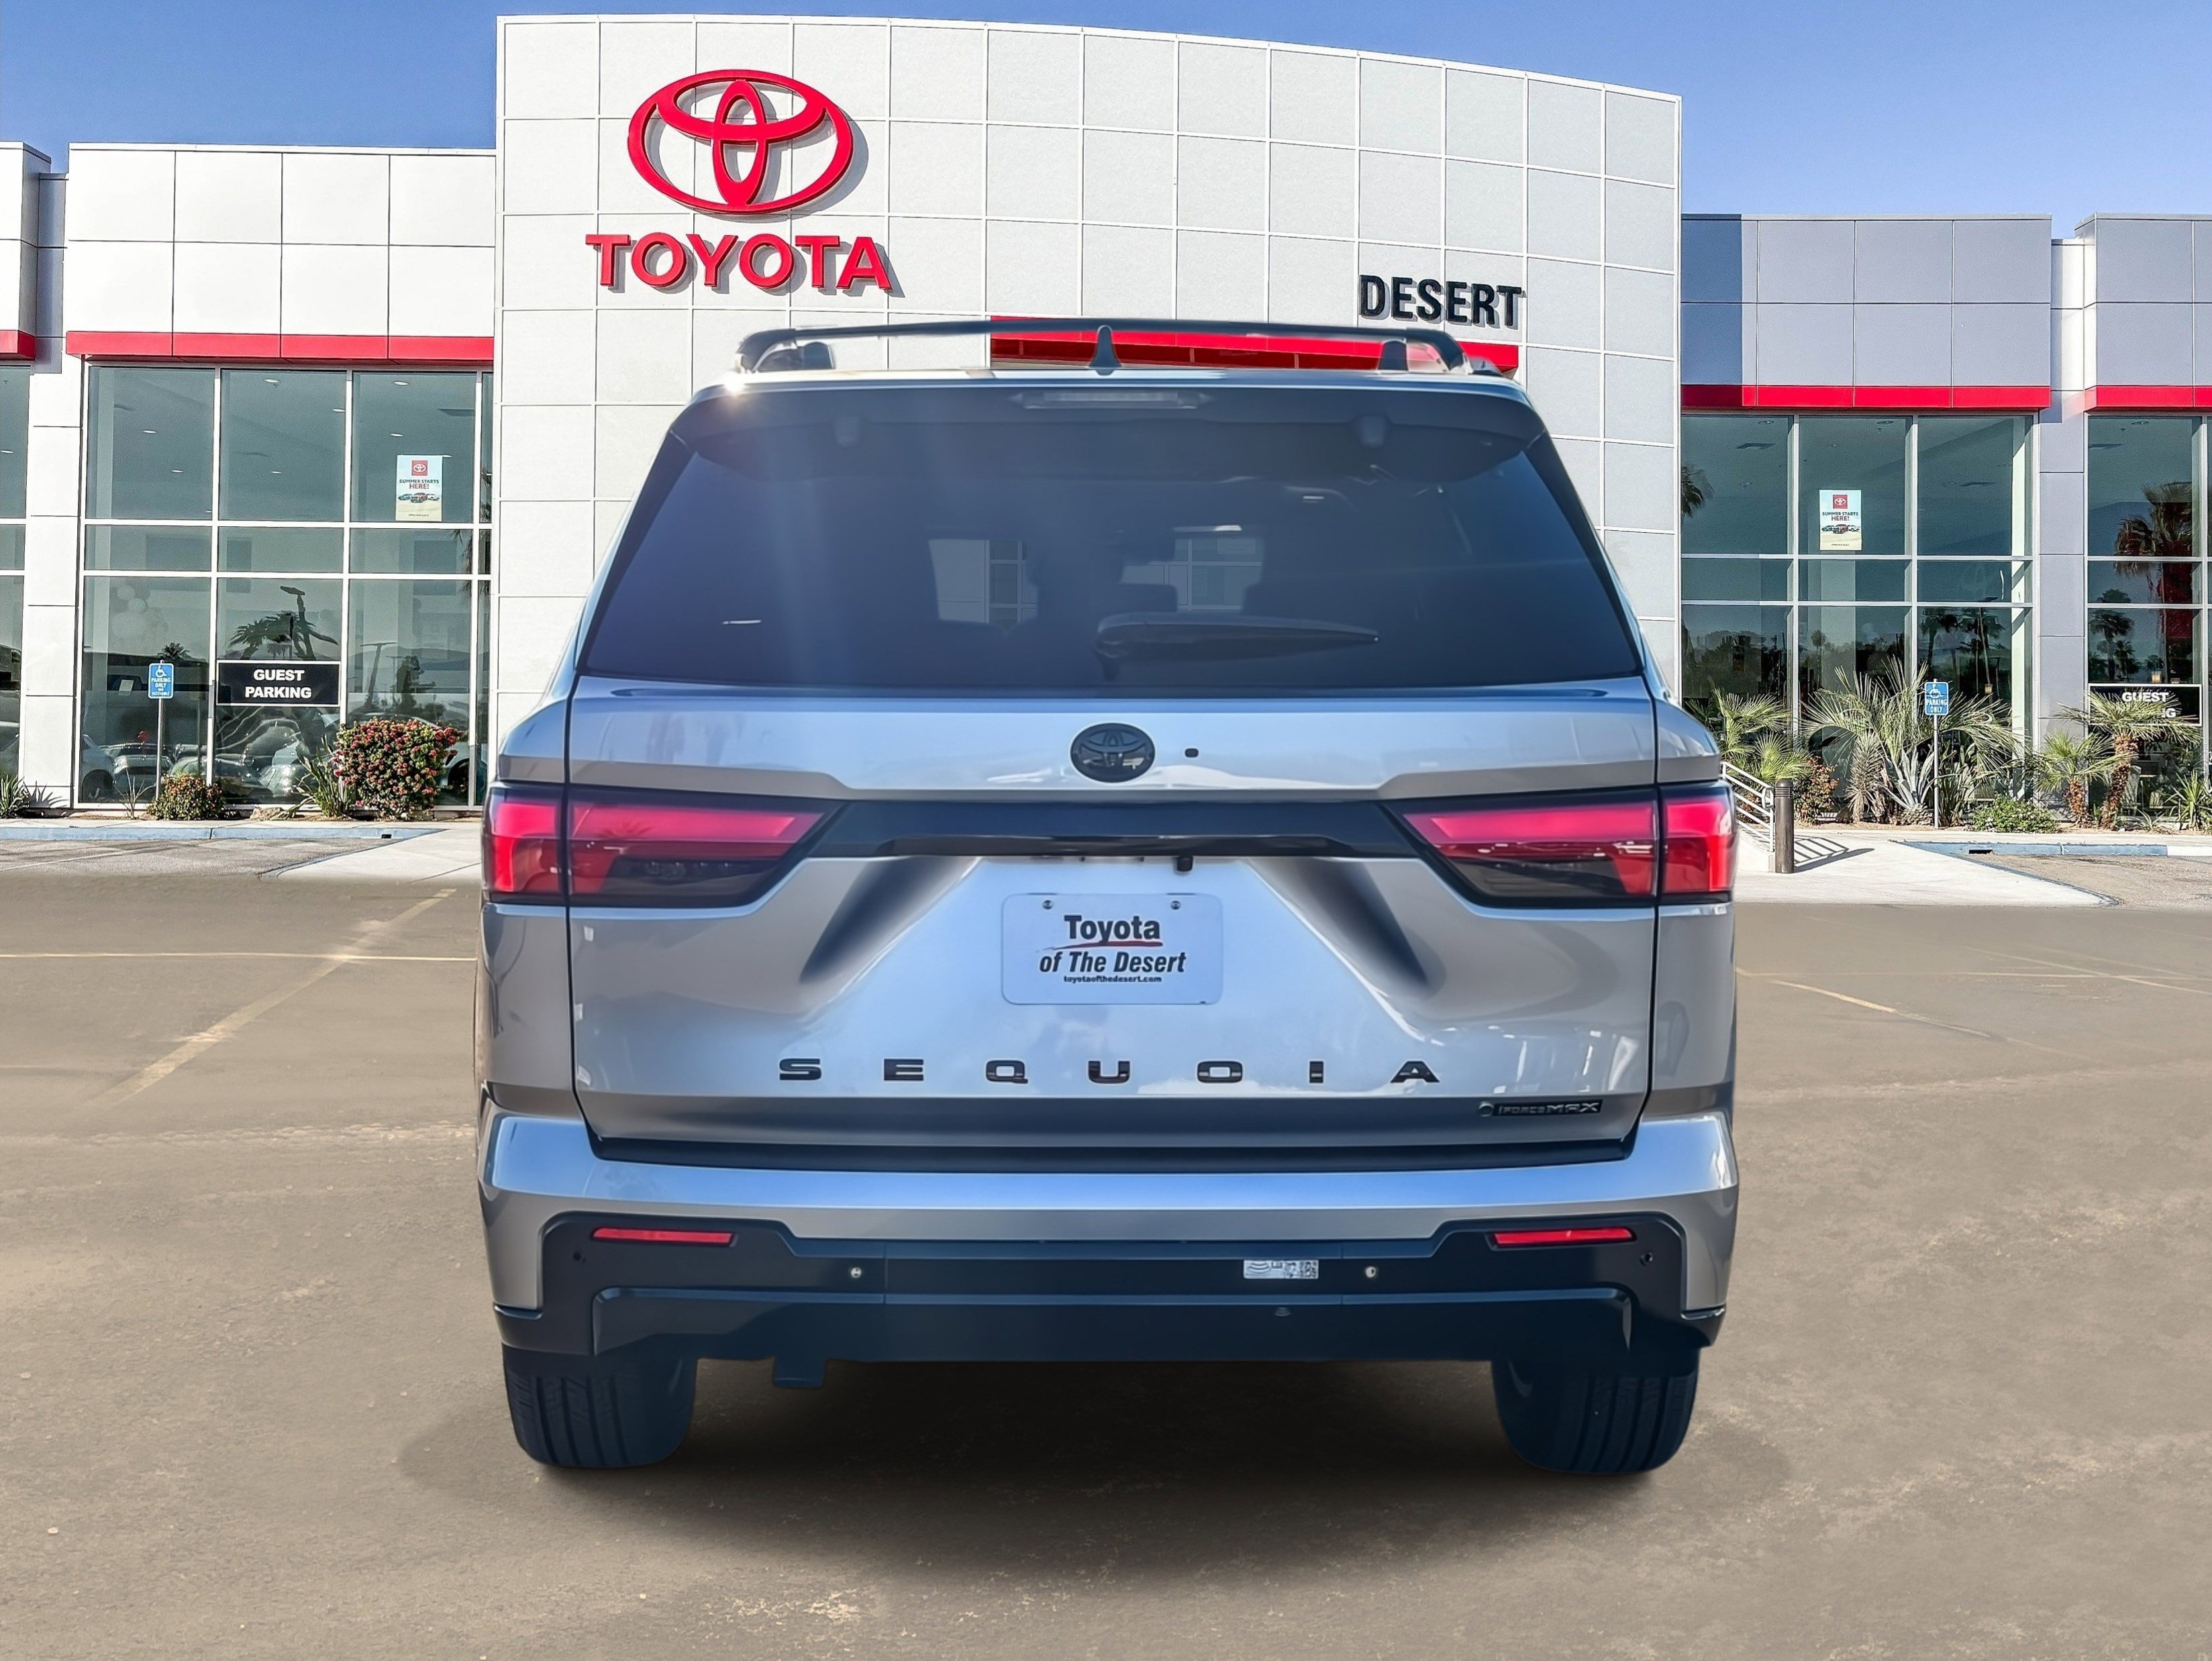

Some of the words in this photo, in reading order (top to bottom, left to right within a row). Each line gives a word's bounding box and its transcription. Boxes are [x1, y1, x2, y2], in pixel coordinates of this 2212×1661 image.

[585, 232, 893, 290] TOYOTA
[1359, 274, 1522, 327] DESERT
[253, 668, 305, 681] GUEST
[245, 686, 312, 699] PARKING
[2121, 692, 2169, 703] GUEST
[1064, 915, 1160, 942] Toyota
[1040, 951, 1062, 972] of
[1069, 951, 1106, 972] The
[1113, 951, 1187, 972] Desert
[1064, 974, 1162, 984] toyotaofthedesert.com
[778, 1058, 1440, 1085] SEQUOIA
